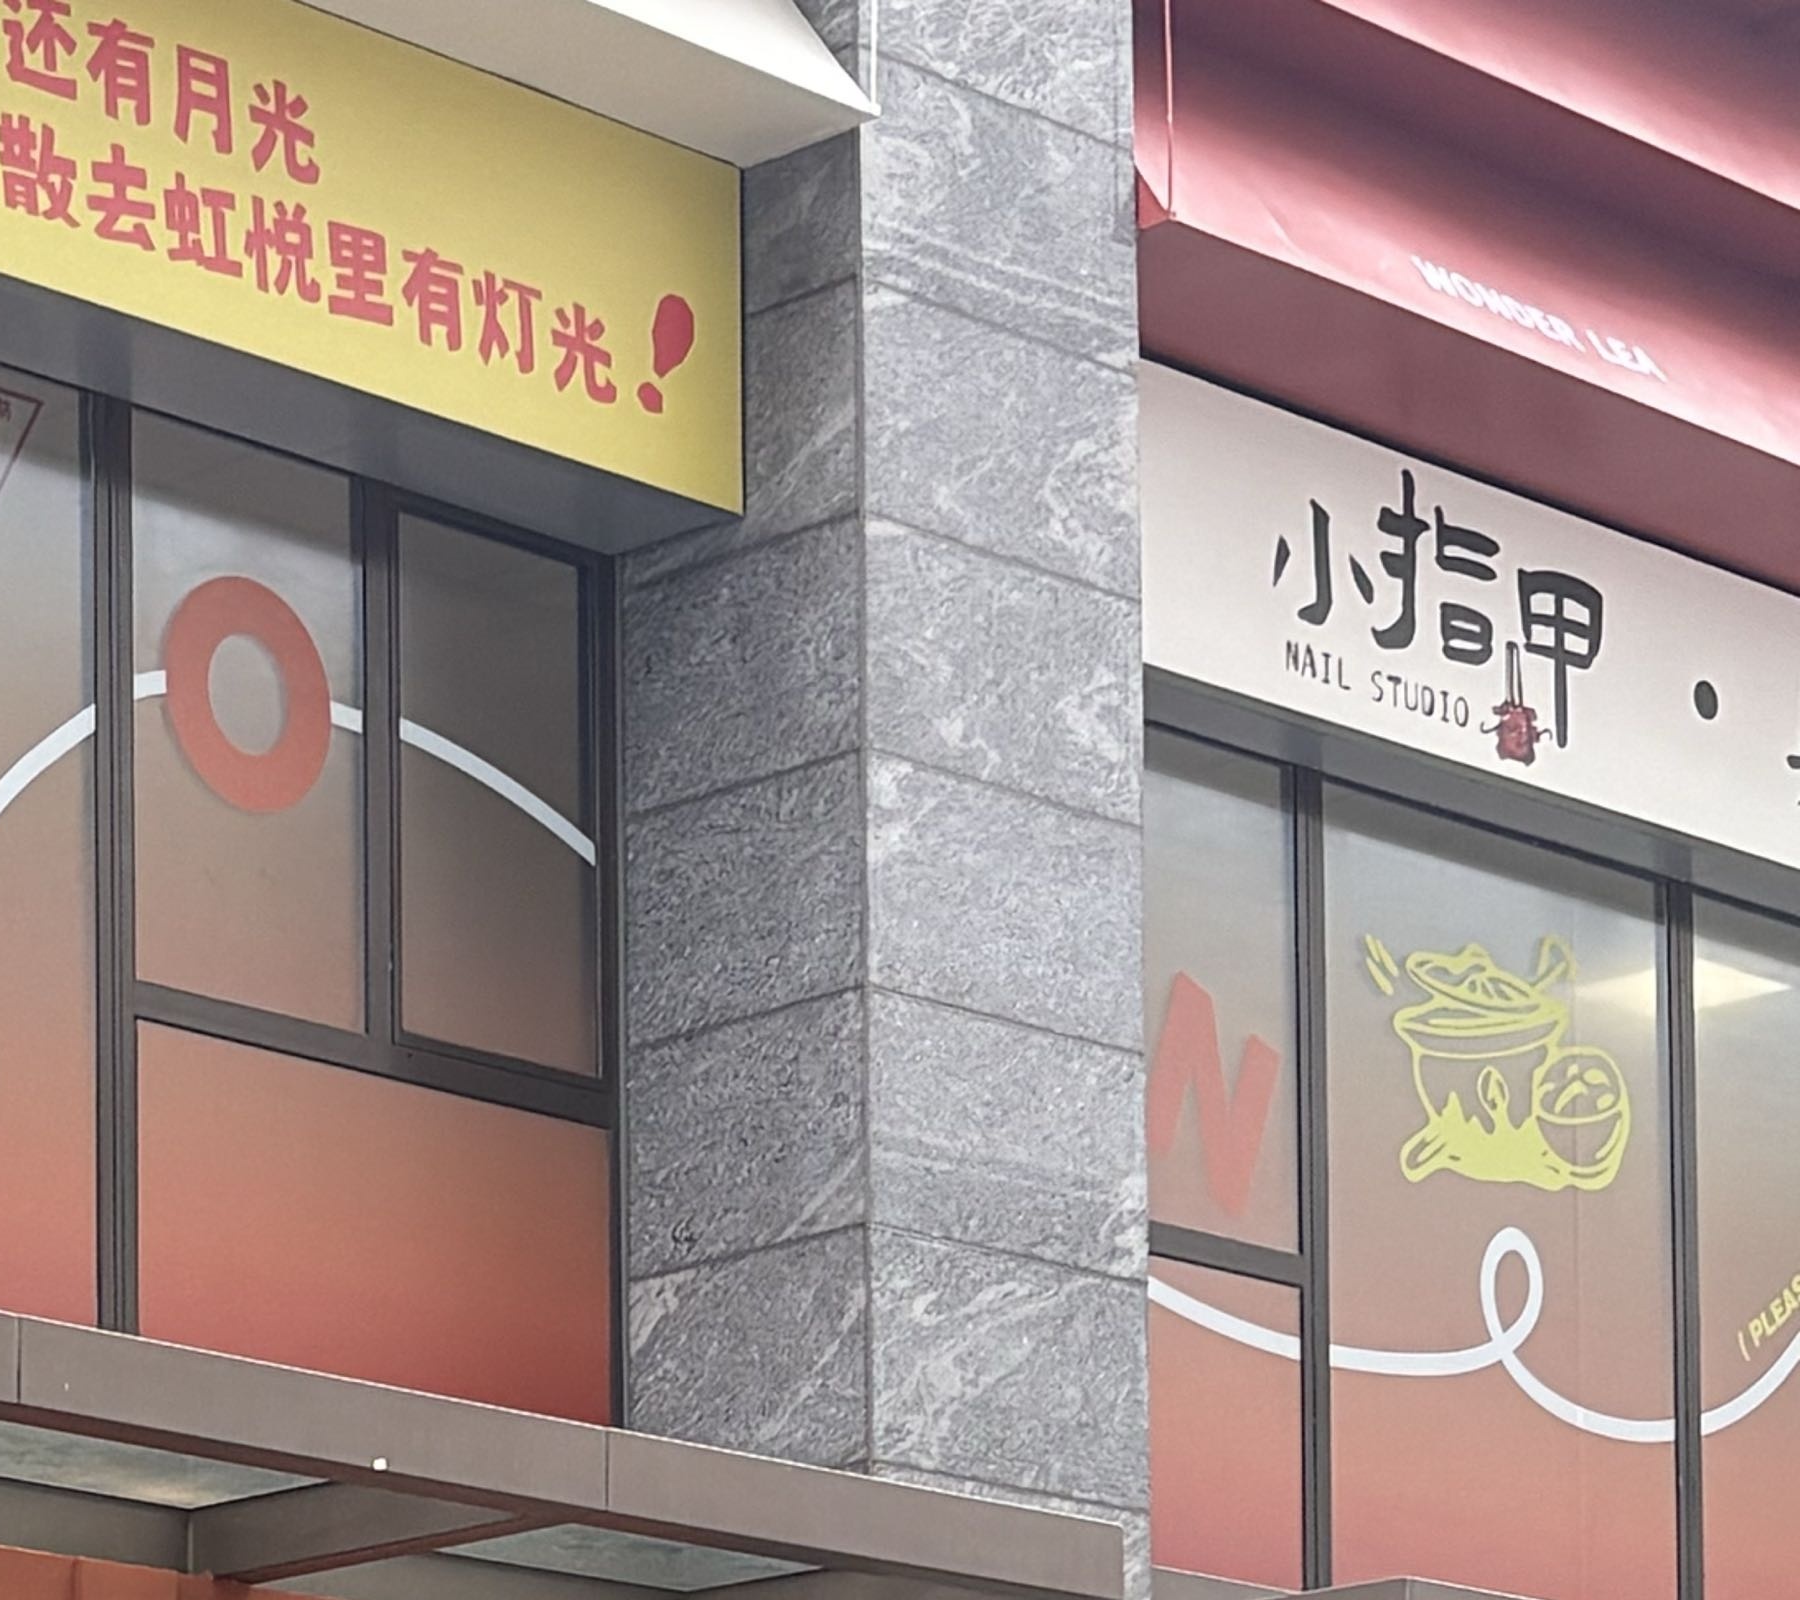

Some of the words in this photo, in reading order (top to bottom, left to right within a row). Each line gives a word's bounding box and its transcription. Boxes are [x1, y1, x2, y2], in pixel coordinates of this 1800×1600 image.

[1410, 254, 1587, 354] WONDER
[1585, 328, 1668, 384] LEA
[1272, 470, 1603, 748] 小指甲
[1286, 640, 1351, 691] NAIL
[1370, 670, 1469, 728] STUDIO
